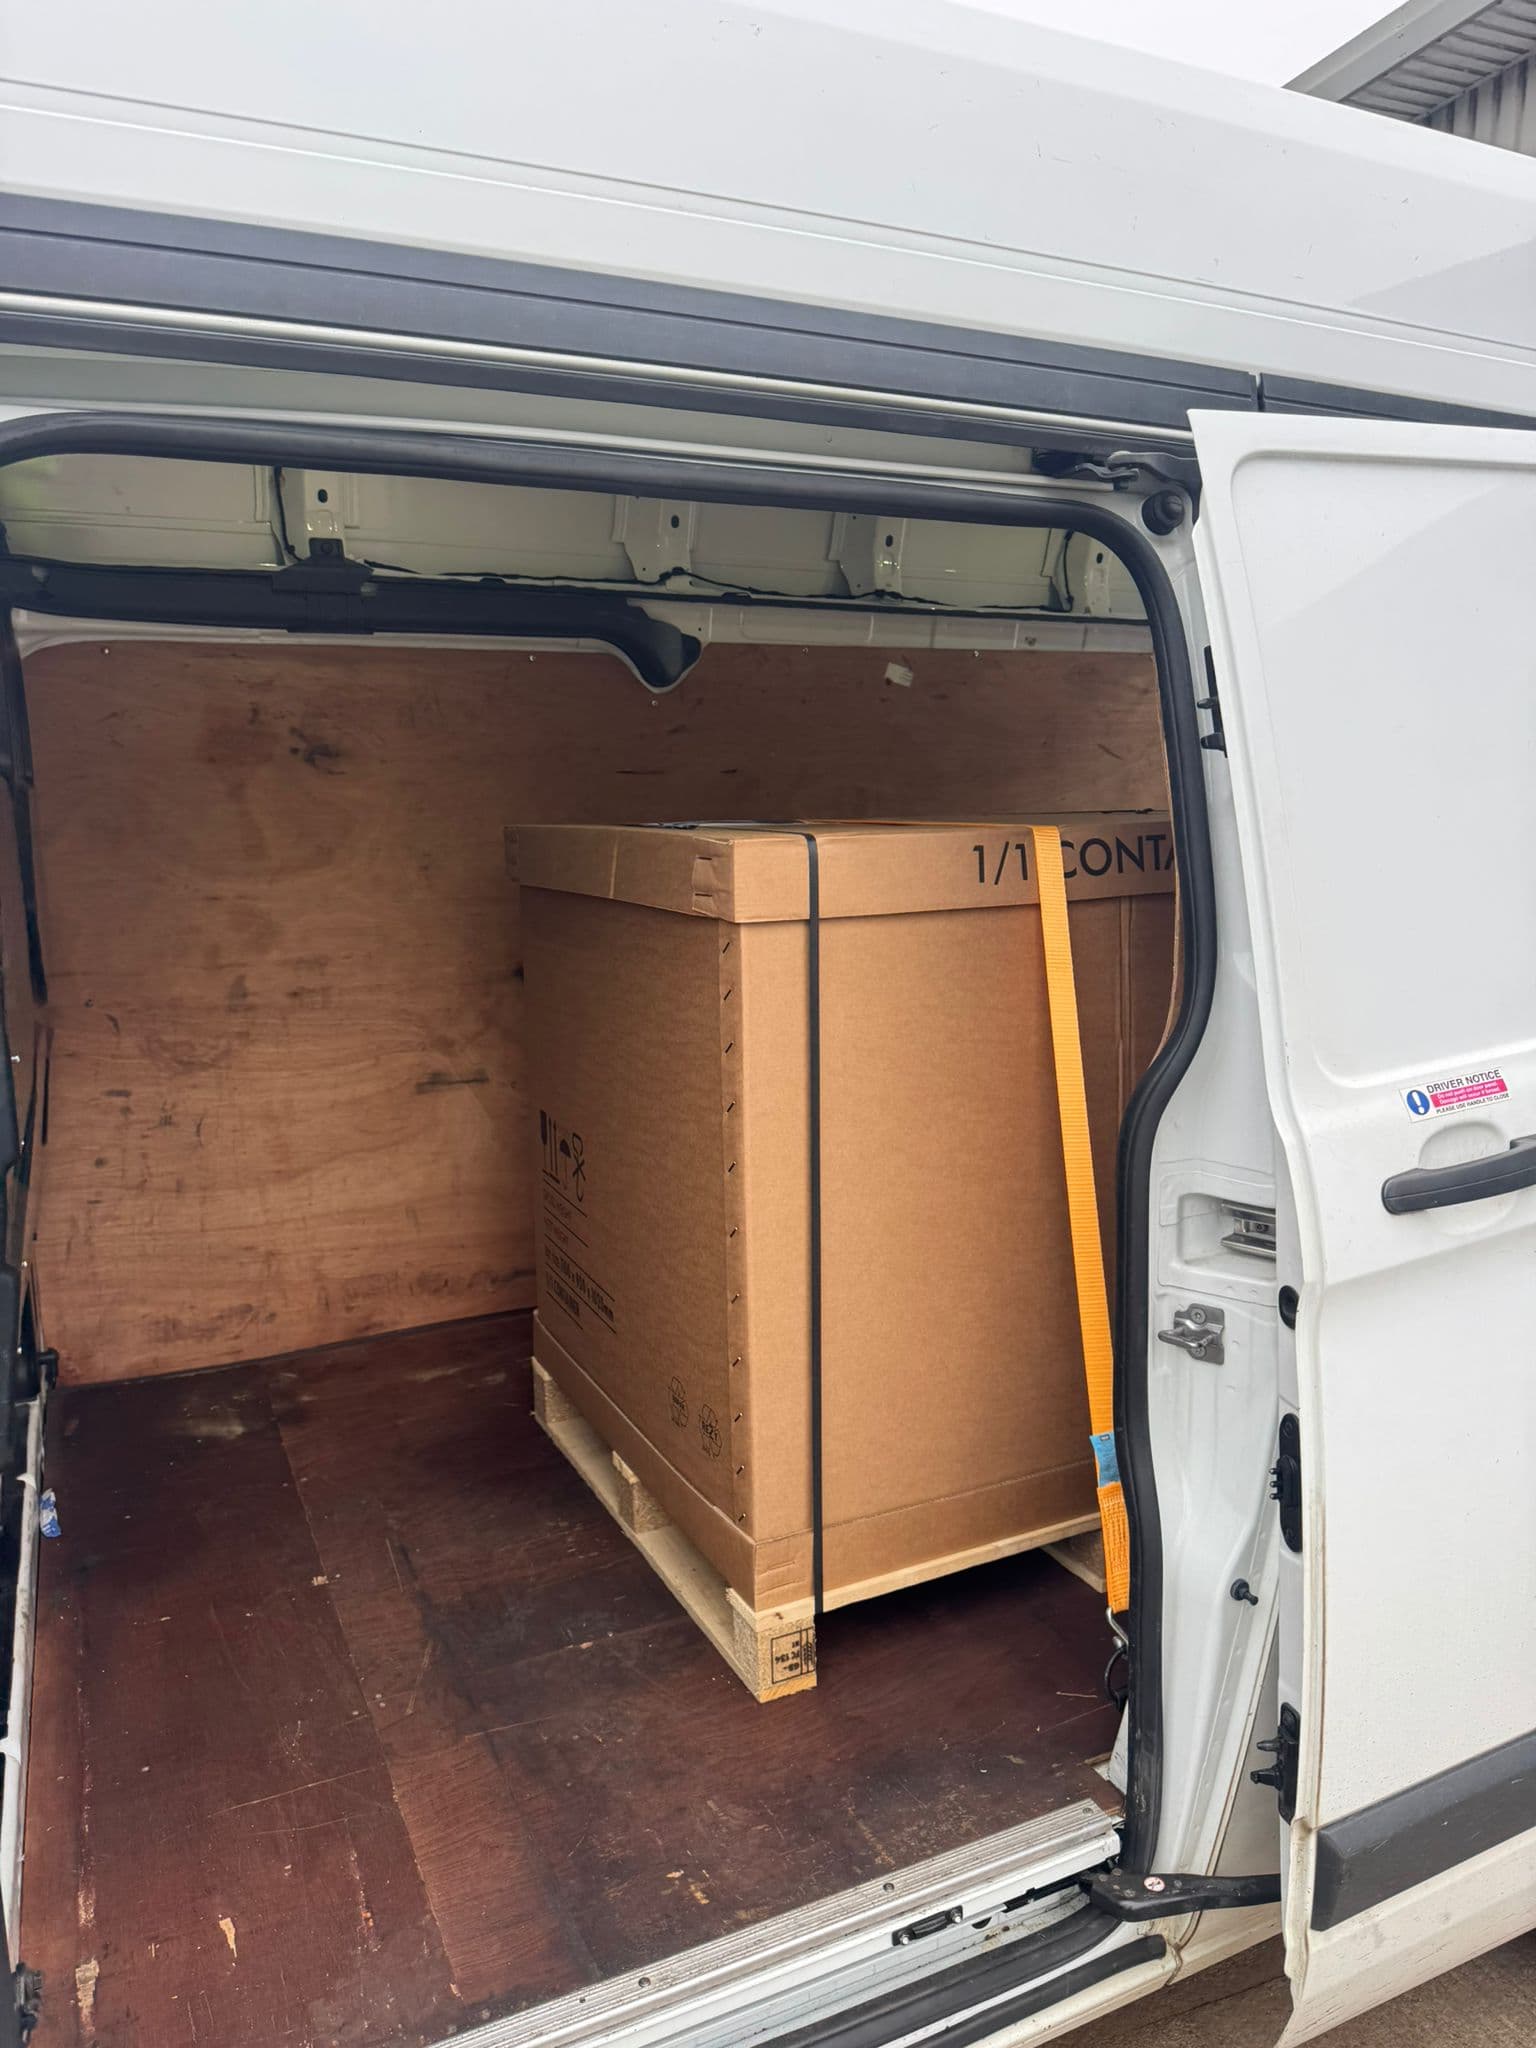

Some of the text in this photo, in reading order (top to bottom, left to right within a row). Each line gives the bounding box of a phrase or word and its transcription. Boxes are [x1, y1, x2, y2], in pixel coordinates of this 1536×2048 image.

[973, 841, 1028, 885] 1/1
[1426, 1069, 1501, 1093] DRIVER NOTICE
[1436, 1105, 1455, 1114] PLEASE
[1466, 1098, 1486, 1107] HANDLE
[1493, 1093, 1509, 1101] CLOSE
